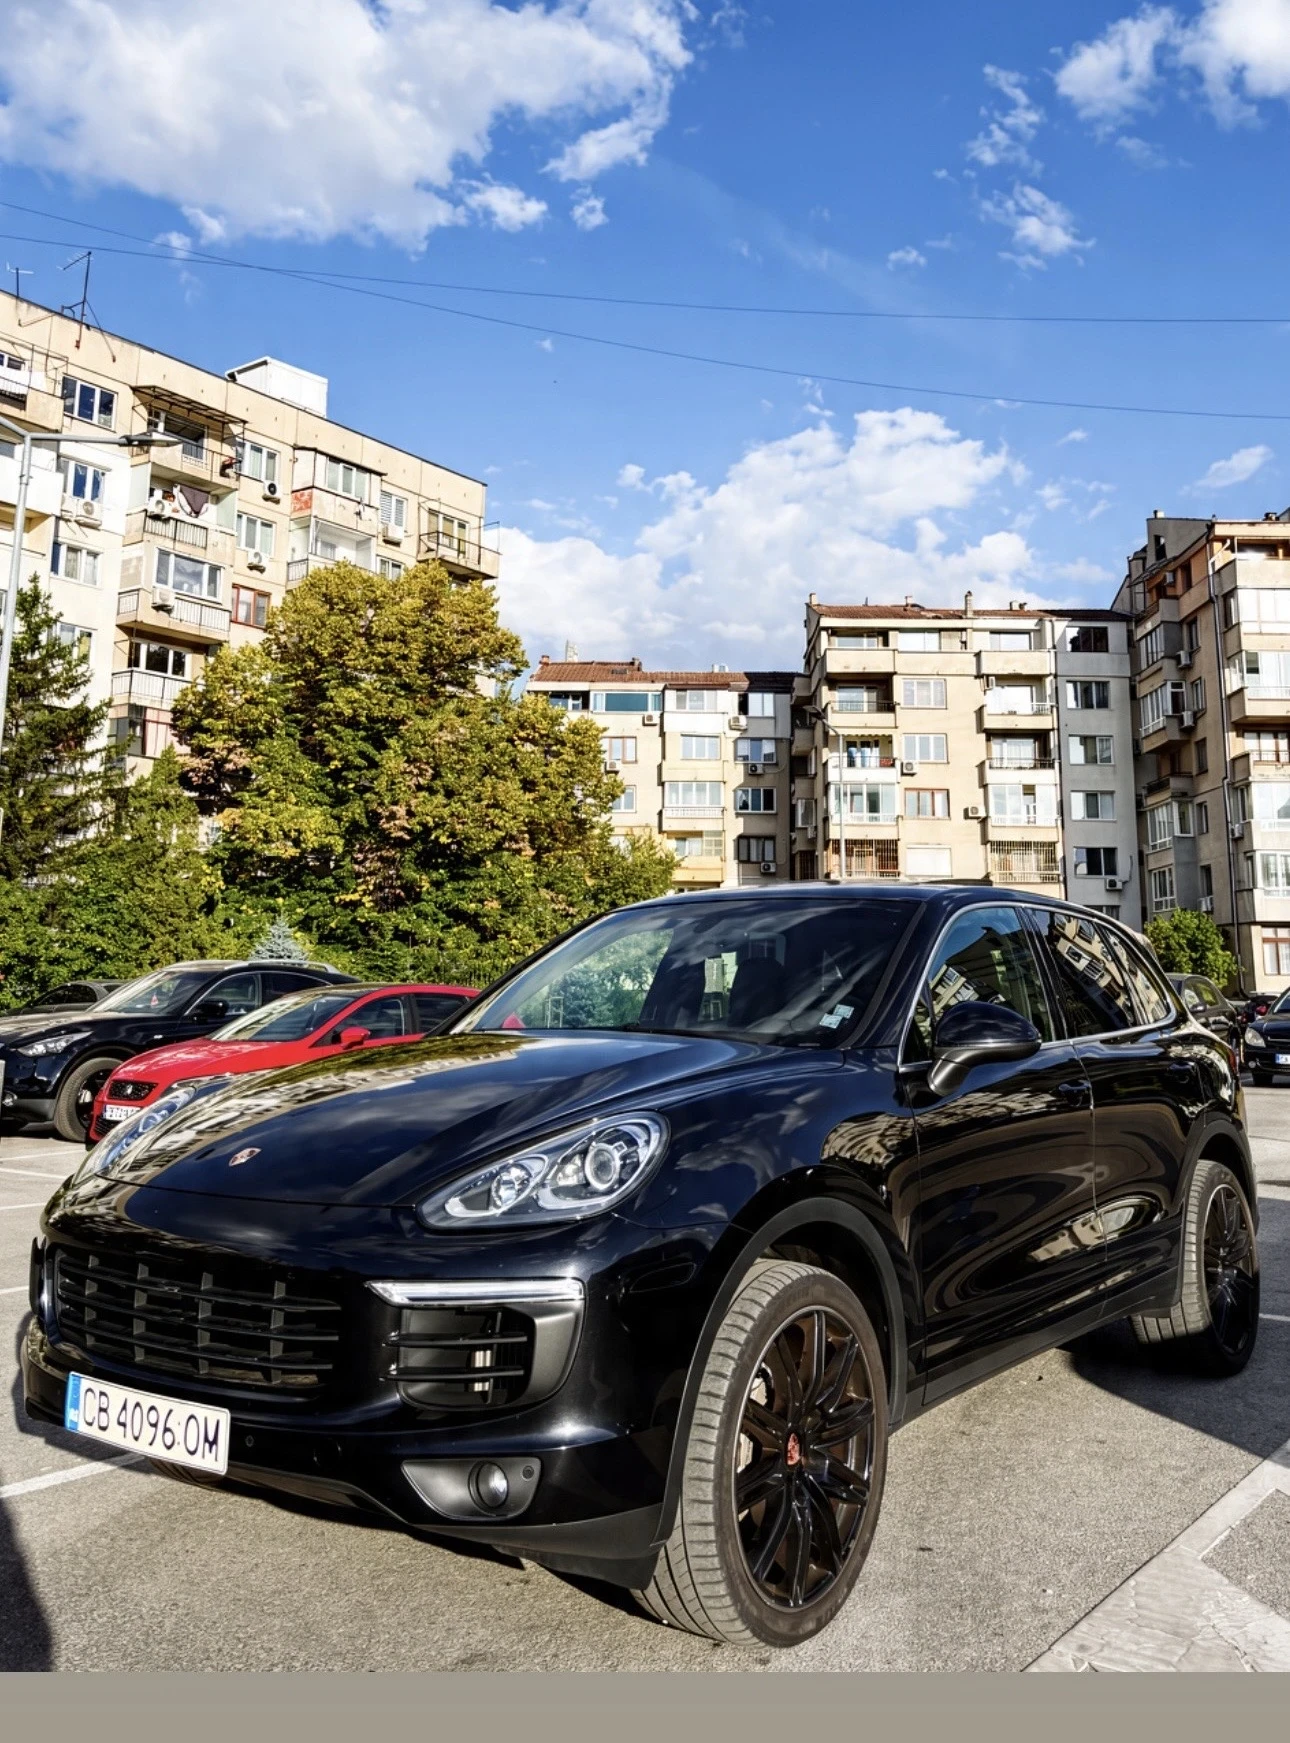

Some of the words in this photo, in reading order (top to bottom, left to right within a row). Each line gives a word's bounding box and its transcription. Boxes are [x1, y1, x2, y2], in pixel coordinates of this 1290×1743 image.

[84, 1387, 110, 1432] CB
[117, 1398, 175, 1450] 4096
[184, 1414, 220, 1462] OM
